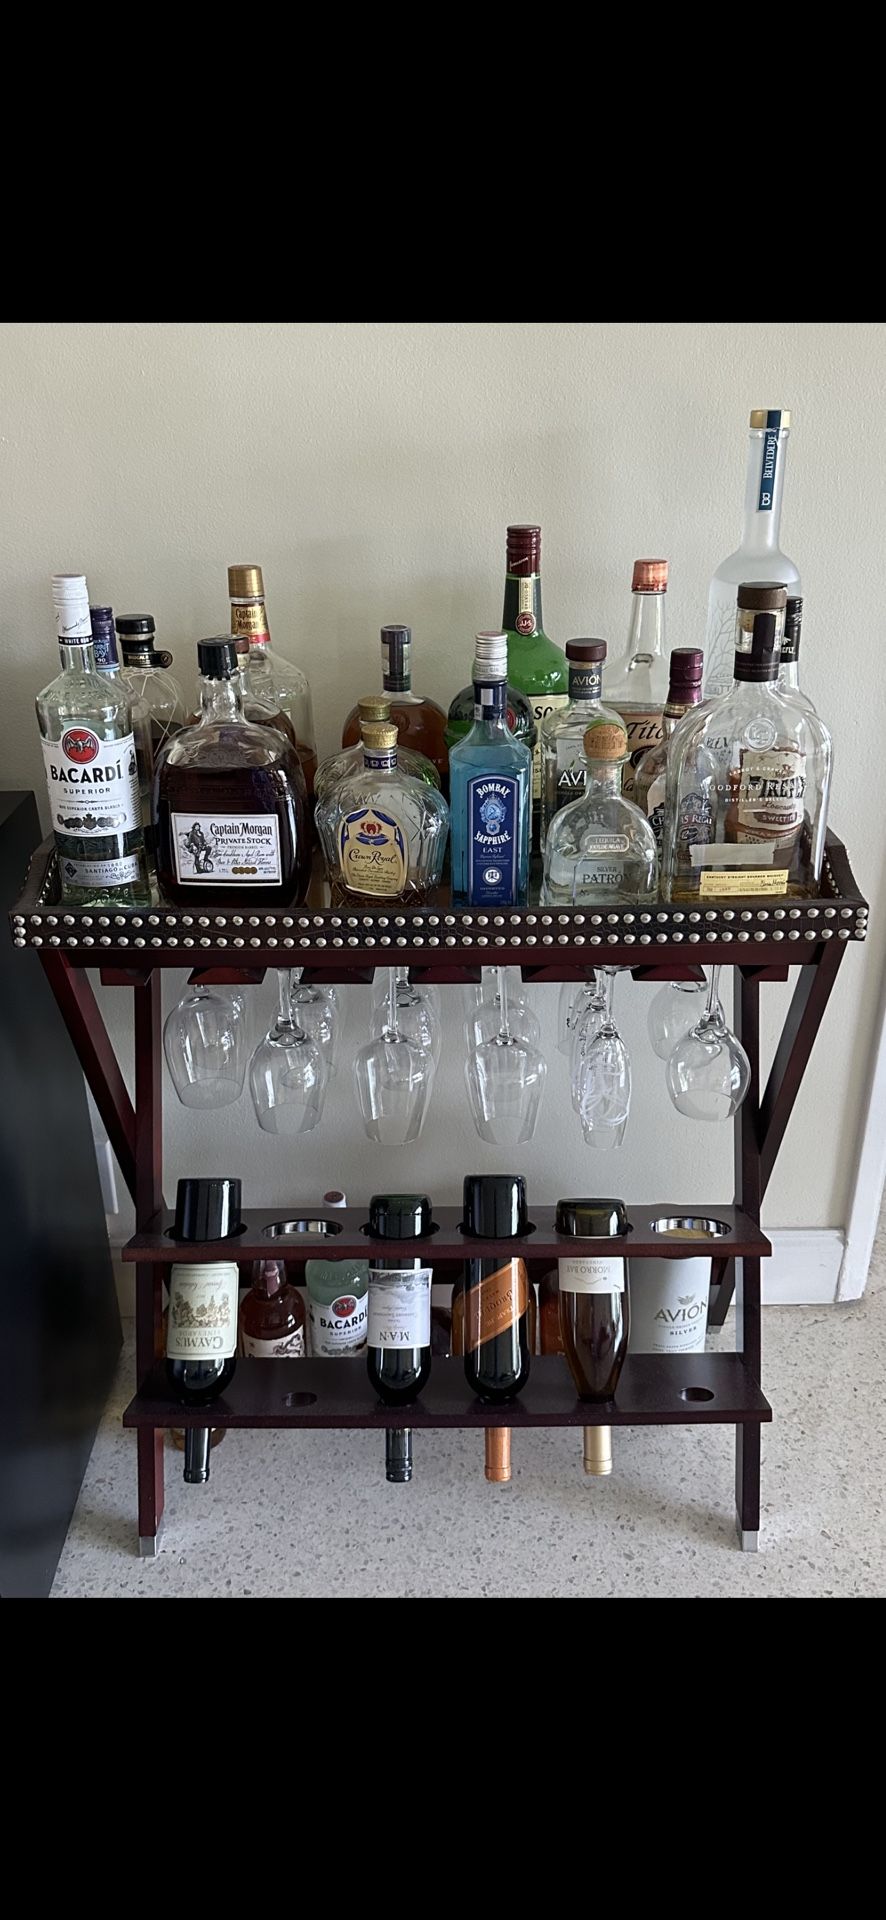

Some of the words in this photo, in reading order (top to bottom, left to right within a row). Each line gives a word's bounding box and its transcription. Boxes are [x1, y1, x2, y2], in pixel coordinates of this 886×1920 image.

[763, 434, 777, 479] BELVEDERE
[572, 673, 602, 686] AVIÓN
[50, 759, 121, 784] BACARDÍ
[558, 770, 587, 786] AVI
[63, 787, 111, 795] SUPERIOR
[476, 783, 511, 799] BOMBAY
[210, 822, 240, 837] Captain
[240, 822, 273, 837] Morgan
[214, 837, 246, 845] PRIVATE
[246, 837, 272, 845] STOCK
[474, 830, 512, 845] SAPPHIRE
[348, 848, 372, 863] Crown
[370, 850, 397, 865] Royal
[566, 1265, 579, 1273] BAY
[653, 1296, 707, 1322] AVIÓN
[670, 1326, 697, 1336] SILVER
[175, 1336, 224, 1350] CAYMUS
